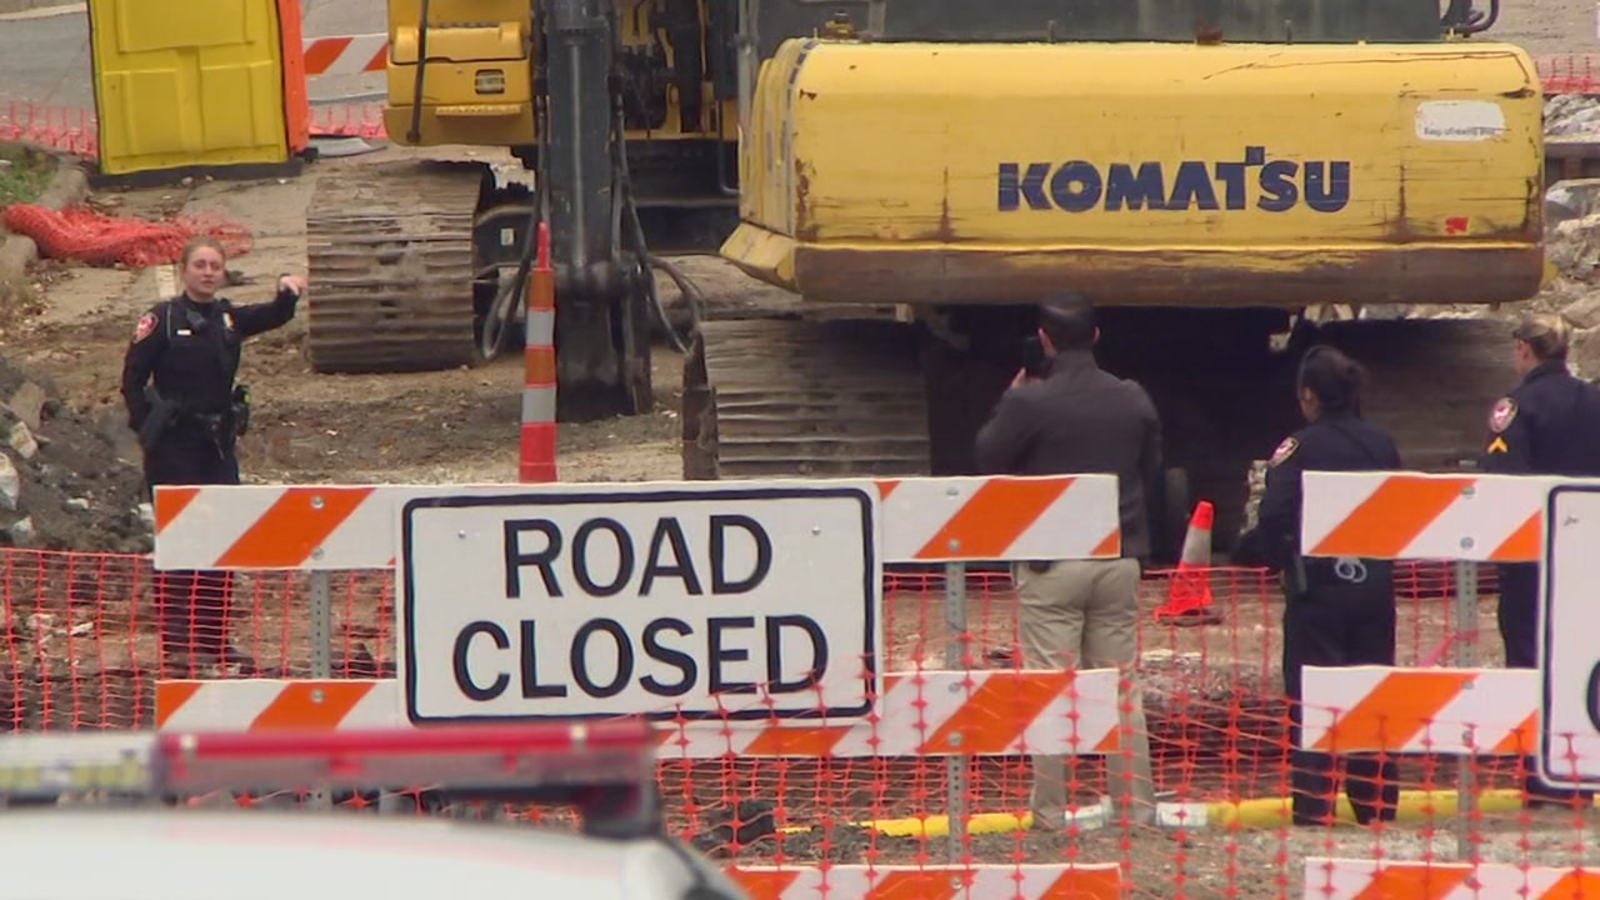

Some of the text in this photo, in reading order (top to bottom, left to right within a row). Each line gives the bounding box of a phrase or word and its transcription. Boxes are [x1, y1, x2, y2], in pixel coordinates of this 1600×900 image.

[998, 146, 1351, 213] KOMATSU
[503, 514, 773, 599] ROAD
[452, 614, 828, 702] CLOSED
